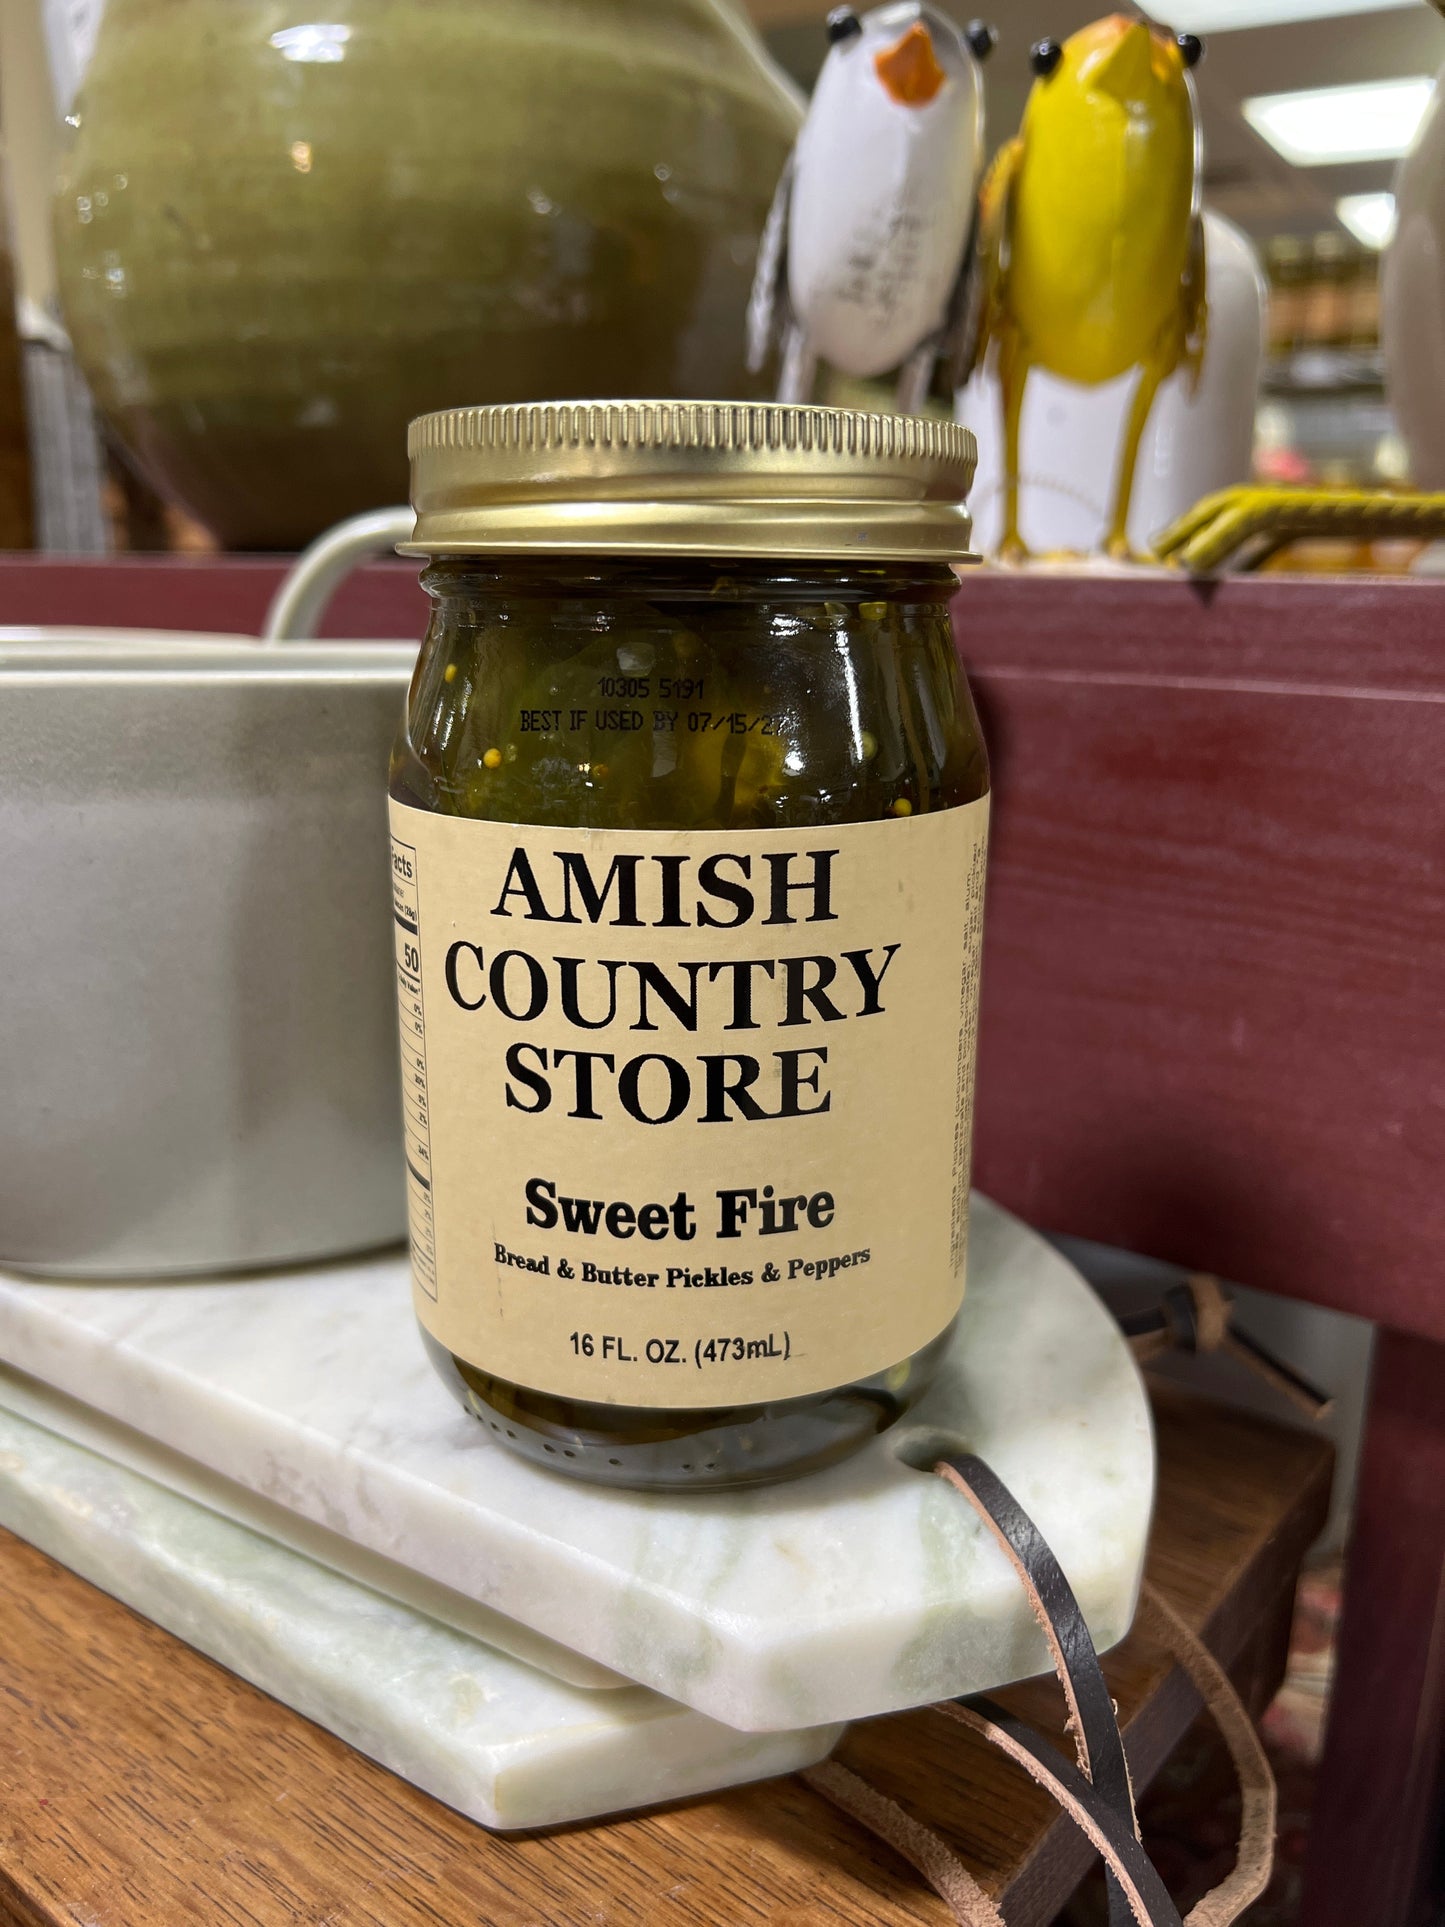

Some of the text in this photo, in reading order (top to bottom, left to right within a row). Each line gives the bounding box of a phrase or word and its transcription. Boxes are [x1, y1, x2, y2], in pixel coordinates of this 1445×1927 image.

[597, 677, 650, 698] 10305
[519, 710, 562, 732] BEST
[569, 710, 588, 732] IF
[595, 711, 644, 732] USED
[653, 711, 679, 733] BY
[392, 845, 413, 879] acts
[490, 847, 840, 928] AMISH
[404, 942, 420, 973] 50
[445, 940, 902, 1032] COUNTRY
[505, 1042, 832, 1126] STORE
[524, 1177, 836, 1241] Sweet Fire
[493, 1241, 872, 1288] Bread & Butter Pickles & Peppers
[569, 1330, 791, 1369] 16 FL. OZ. (473mL)
